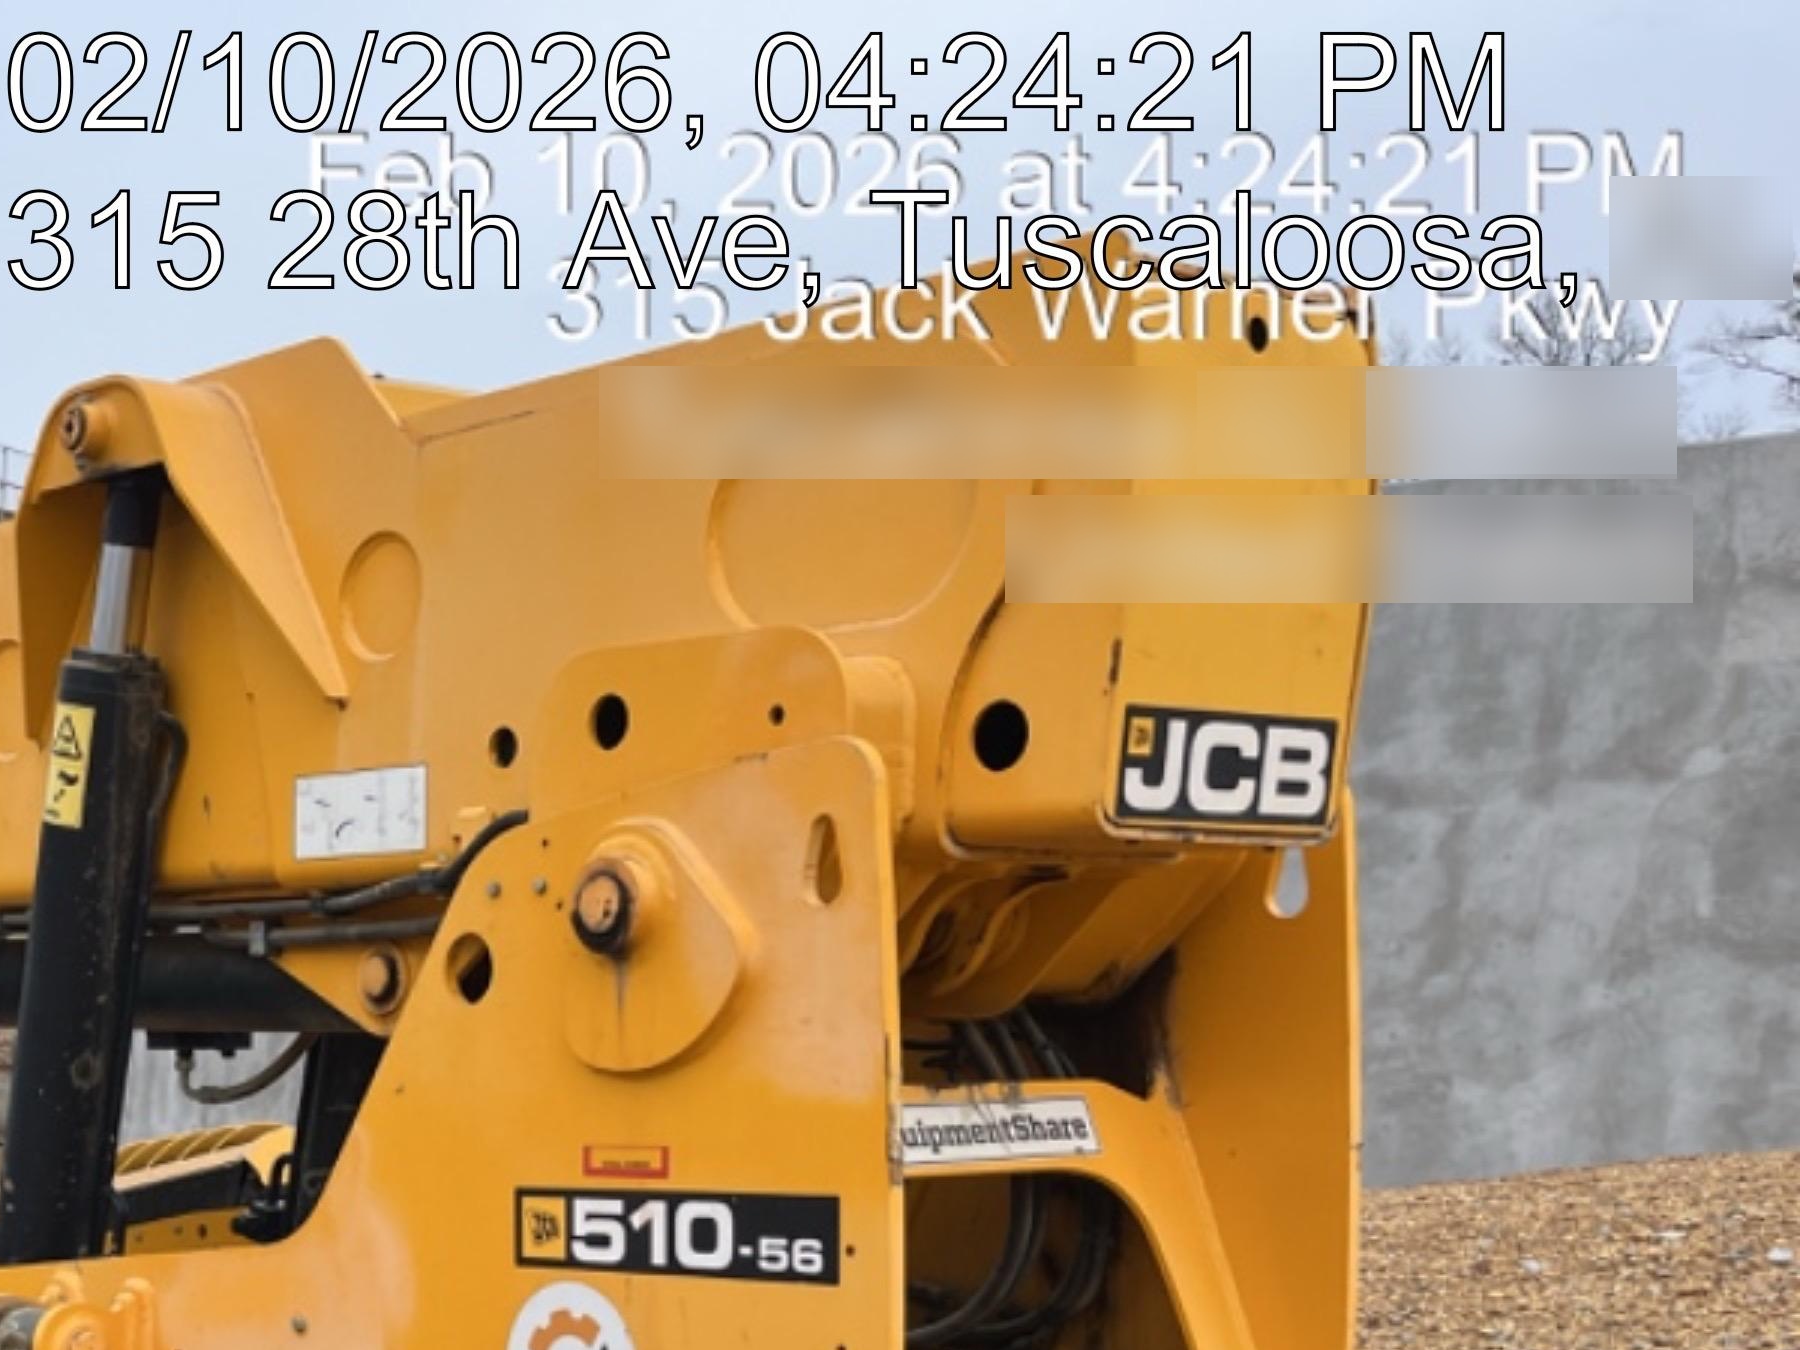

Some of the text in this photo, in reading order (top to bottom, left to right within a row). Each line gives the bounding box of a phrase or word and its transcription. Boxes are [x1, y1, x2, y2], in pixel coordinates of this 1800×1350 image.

[1123, 718, 1330, 817] JCB
[900, 1113, 1089, 1155] uipmentShare
[570, 1196, 824, 1275] 510-56
